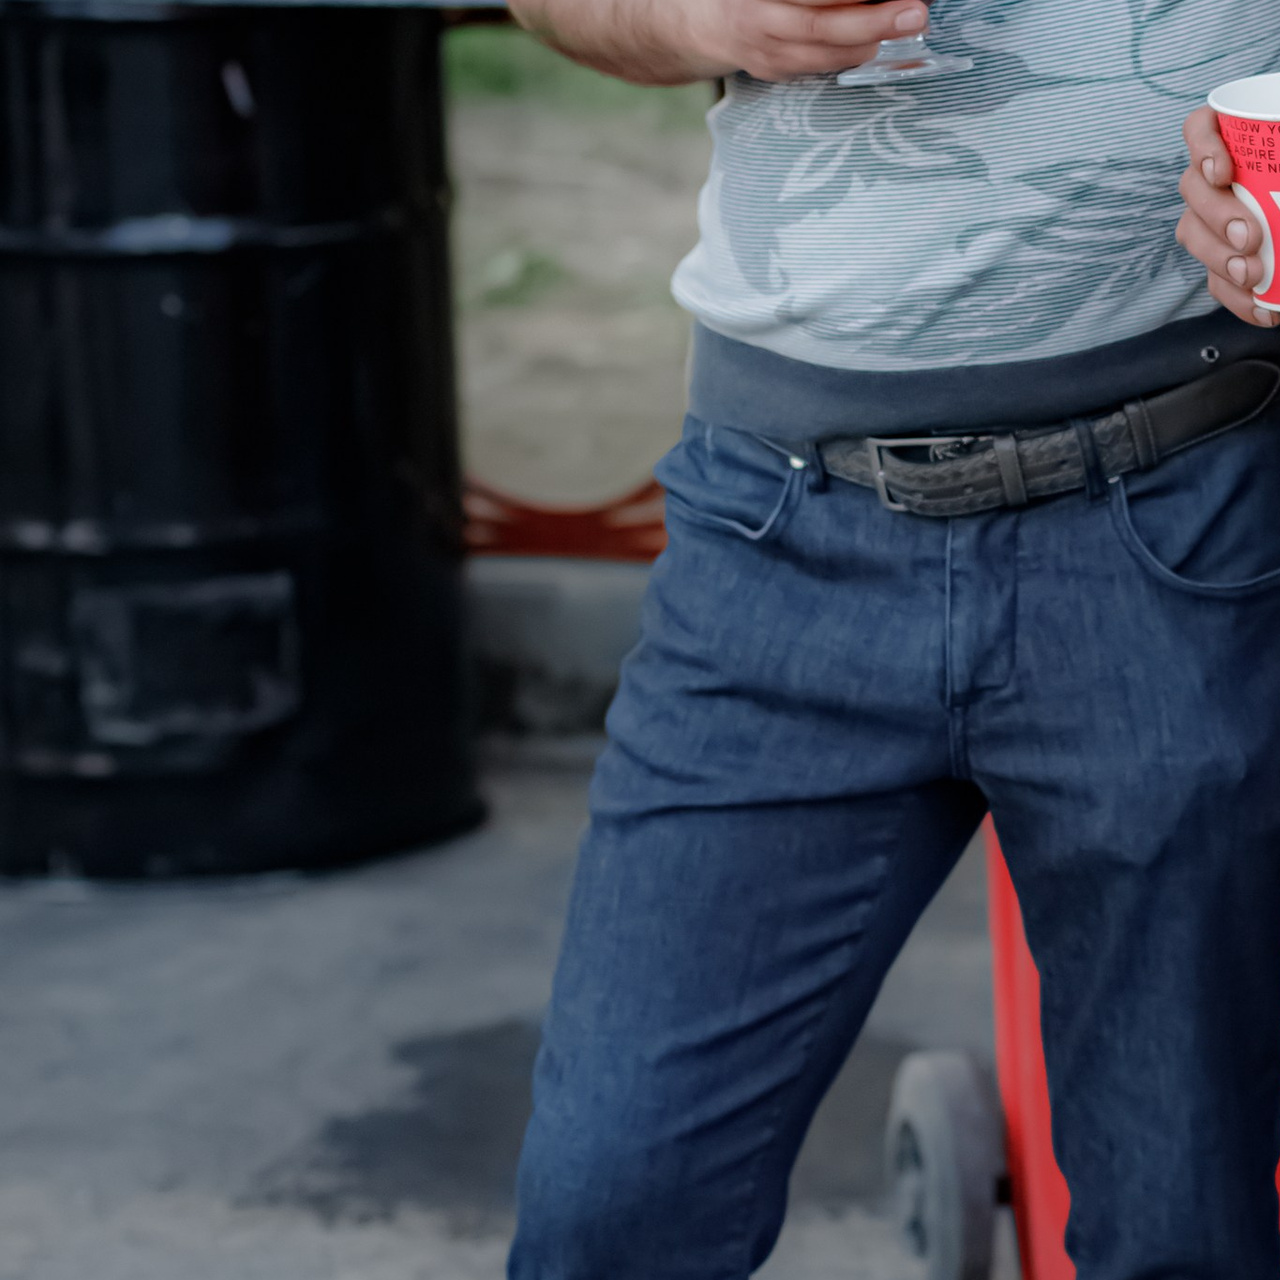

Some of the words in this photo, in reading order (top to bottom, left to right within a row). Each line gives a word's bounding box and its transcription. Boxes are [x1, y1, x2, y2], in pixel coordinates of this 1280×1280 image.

[1233, 132, 1255, 146] LIFE
[1261, 137, 1275, 147] IS
[1234, 145, 1276, 160] ASPIRE
[1245, 161, 1263, 172] WE
